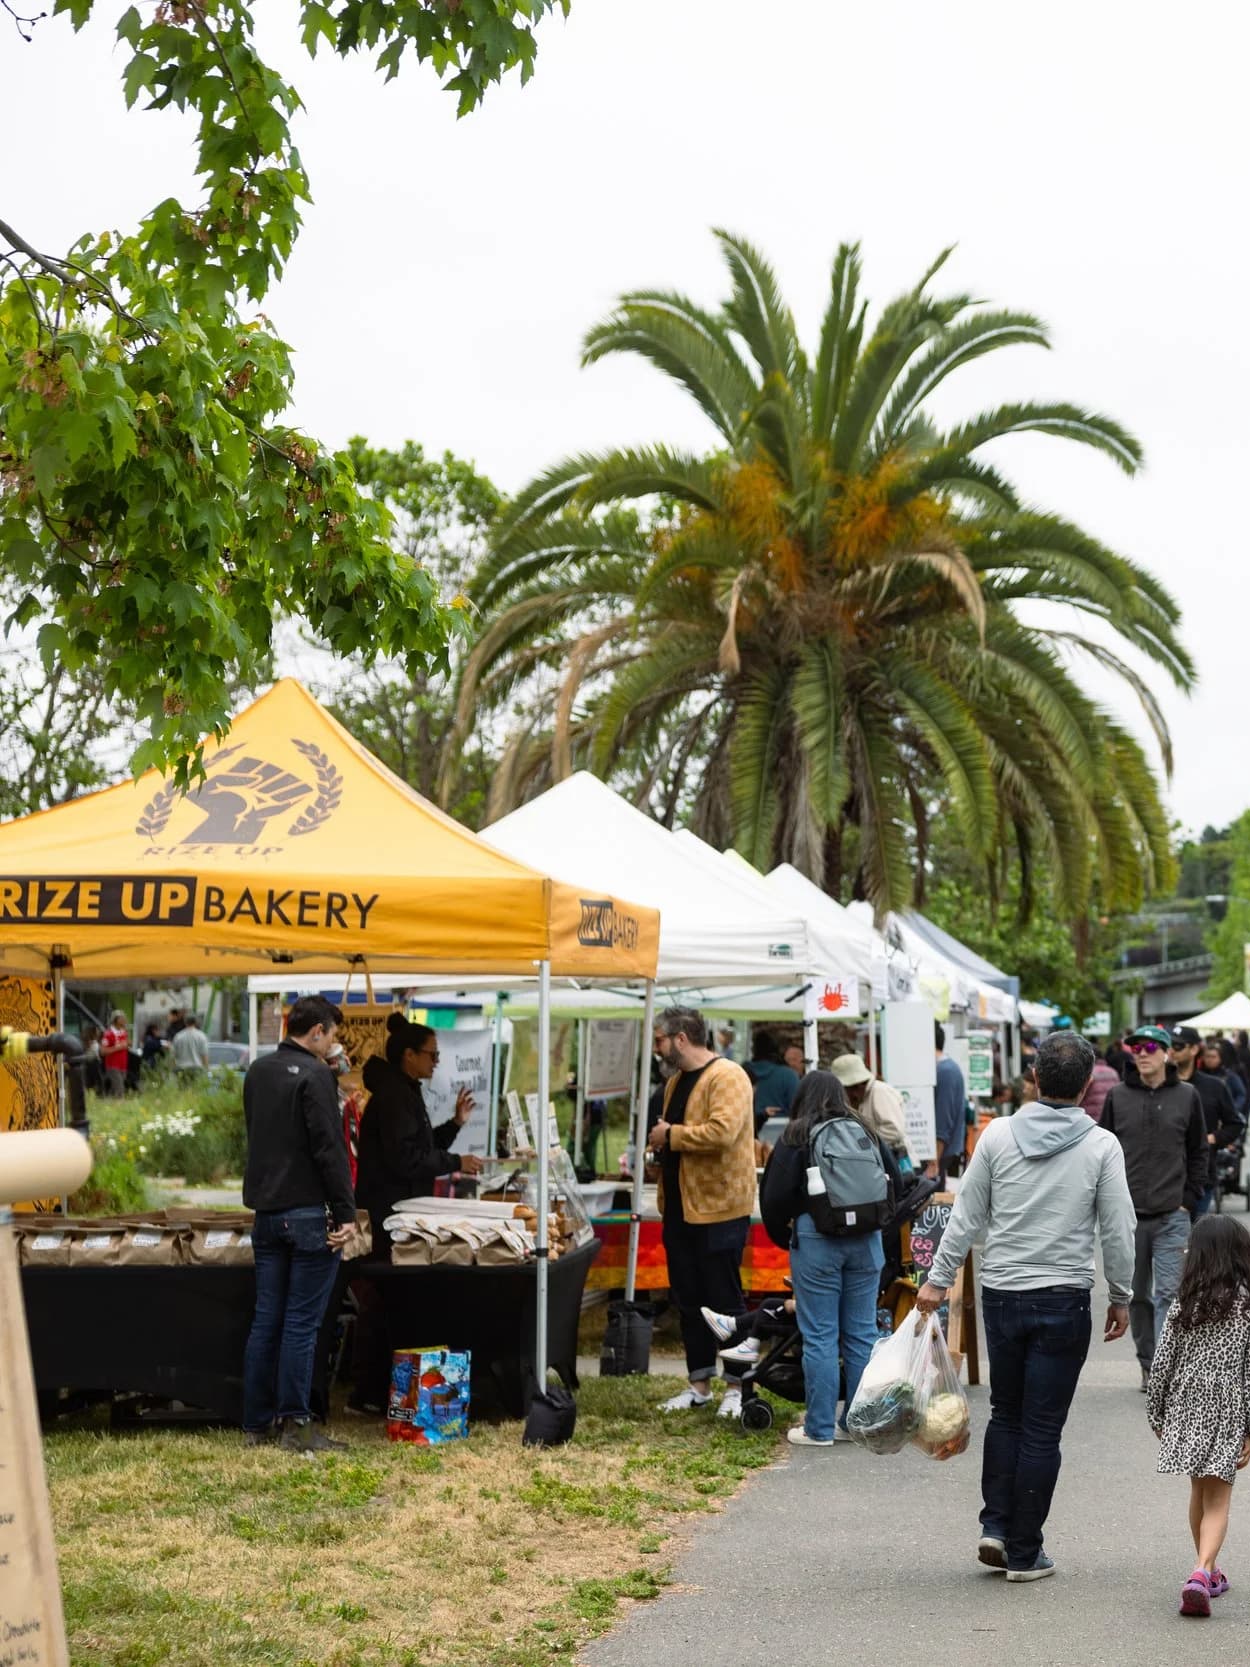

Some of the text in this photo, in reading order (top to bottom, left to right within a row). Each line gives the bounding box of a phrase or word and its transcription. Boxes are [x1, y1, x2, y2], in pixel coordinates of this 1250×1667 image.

[142, 845, 285, 856] RIZE UP
[0, 879, 381, 930] RIZE UP BAKERY
[613, 910, 639, 951] BAKERY
